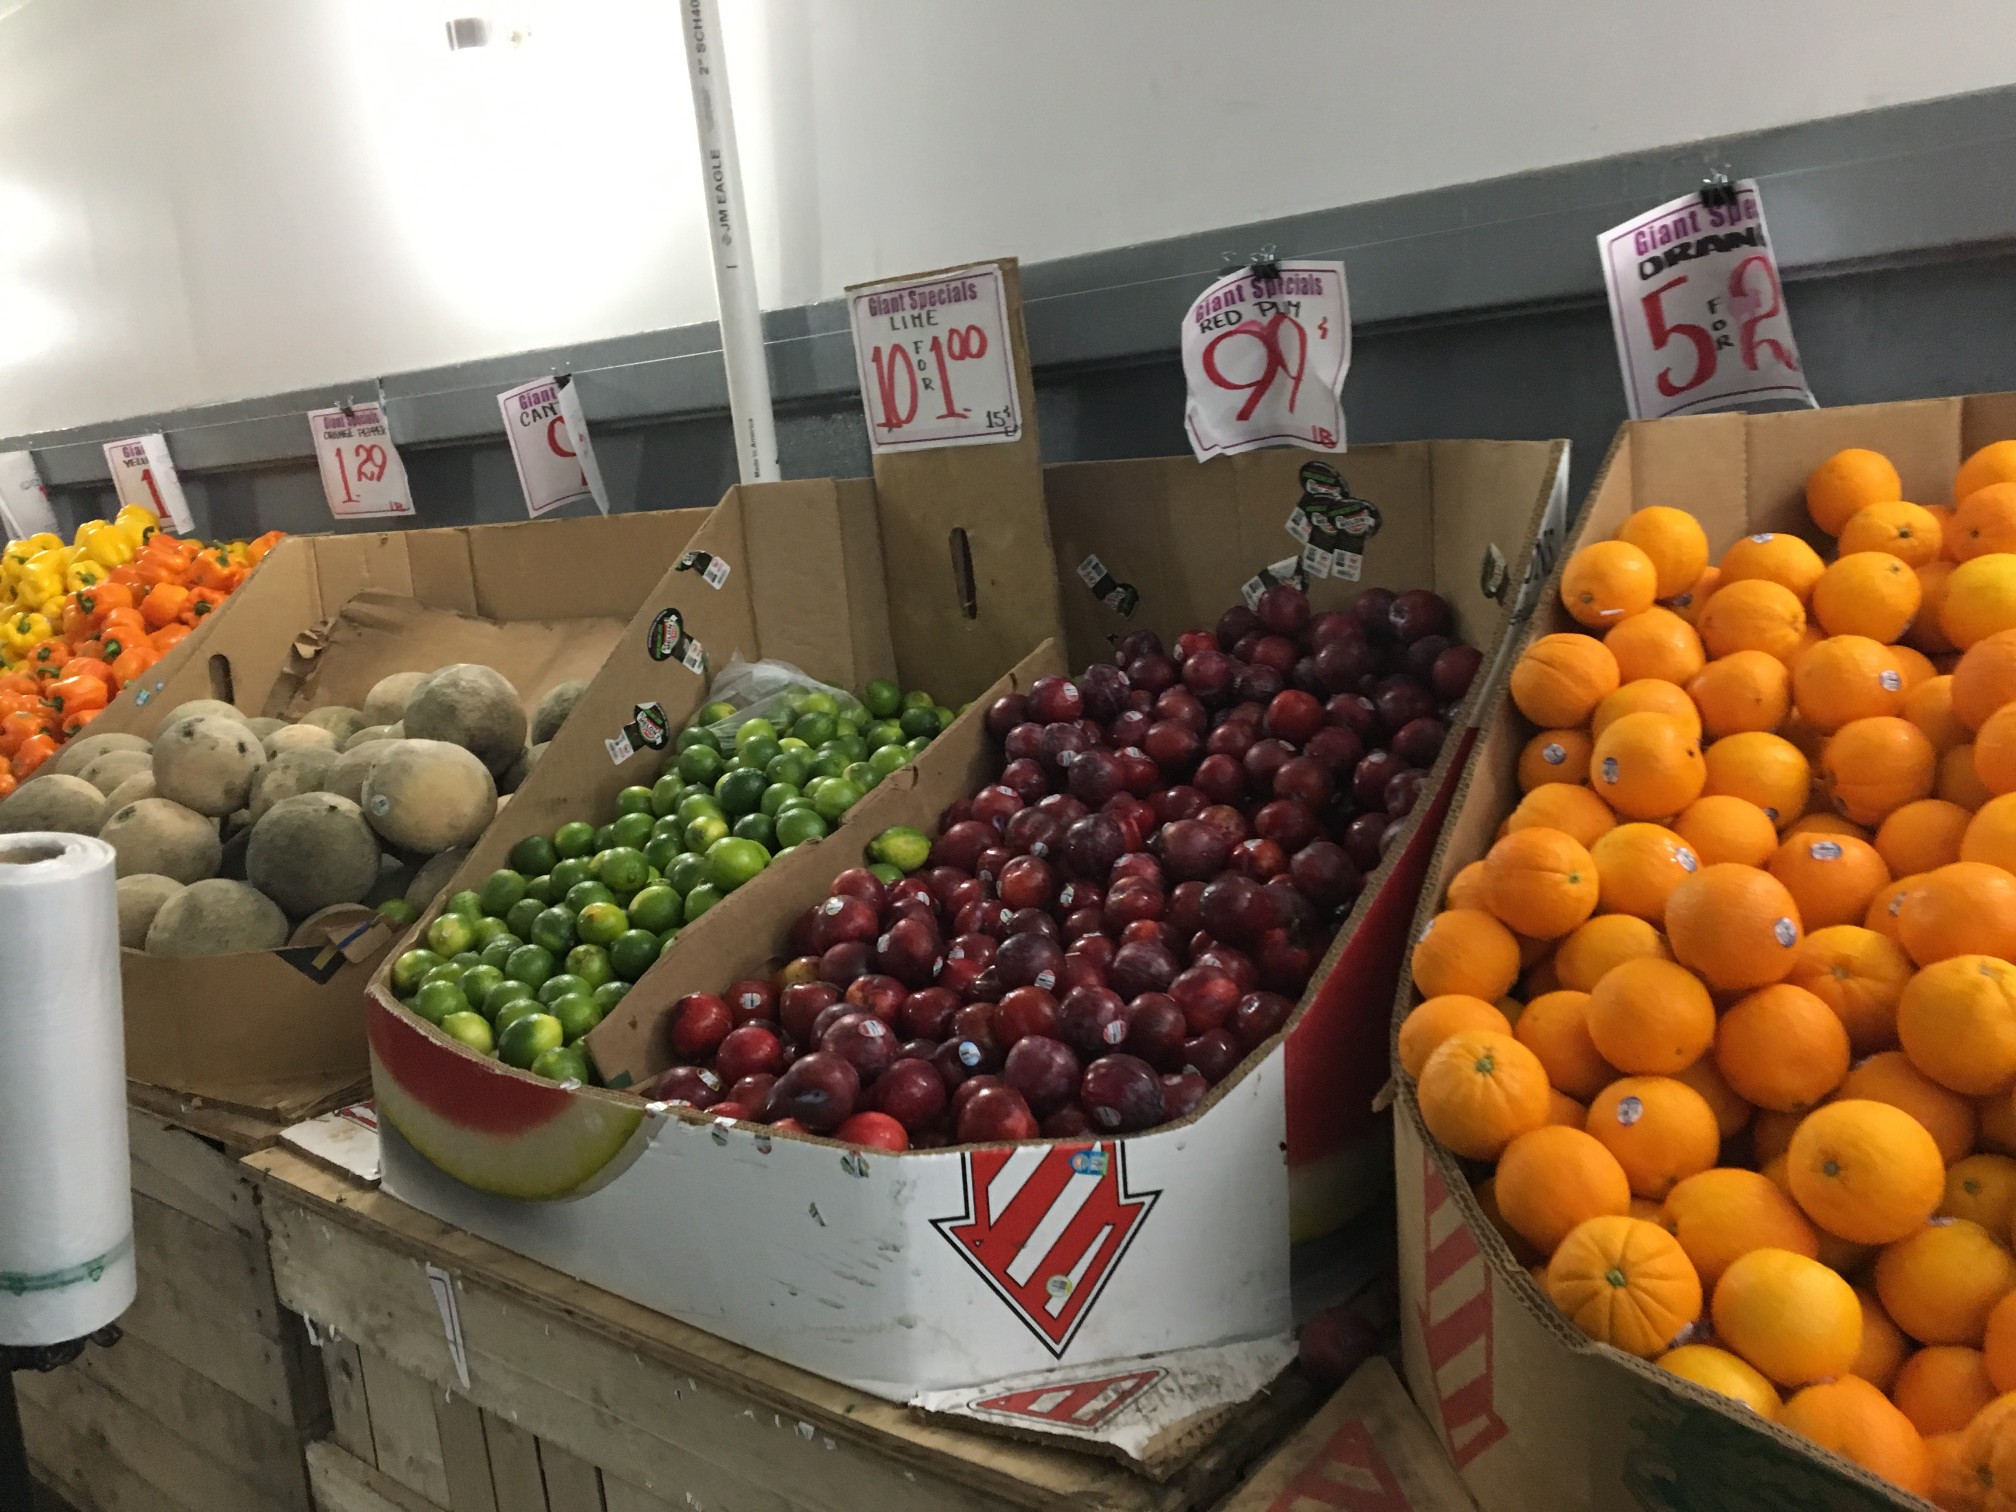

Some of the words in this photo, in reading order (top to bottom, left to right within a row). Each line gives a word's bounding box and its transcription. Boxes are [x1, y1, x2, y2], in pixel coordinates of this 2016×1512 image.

[709, 149, 727, 205] EAGLE
[1634, 210, 1701, 256] Giant
[868, 293, 907, 318] Giant
[909, 281, 978, 311] Specials
[889, 309, 939, 332] LIME
[1195, 283, 1246, 324] Giant
[1252, 273, 1323, 300] Specials
[1200, 310, 1243, 334] RED
[1641, 275, 1718, 397] 5
[518, 385, 558, 411] Giant
[871, 343, 919, 429] 10
